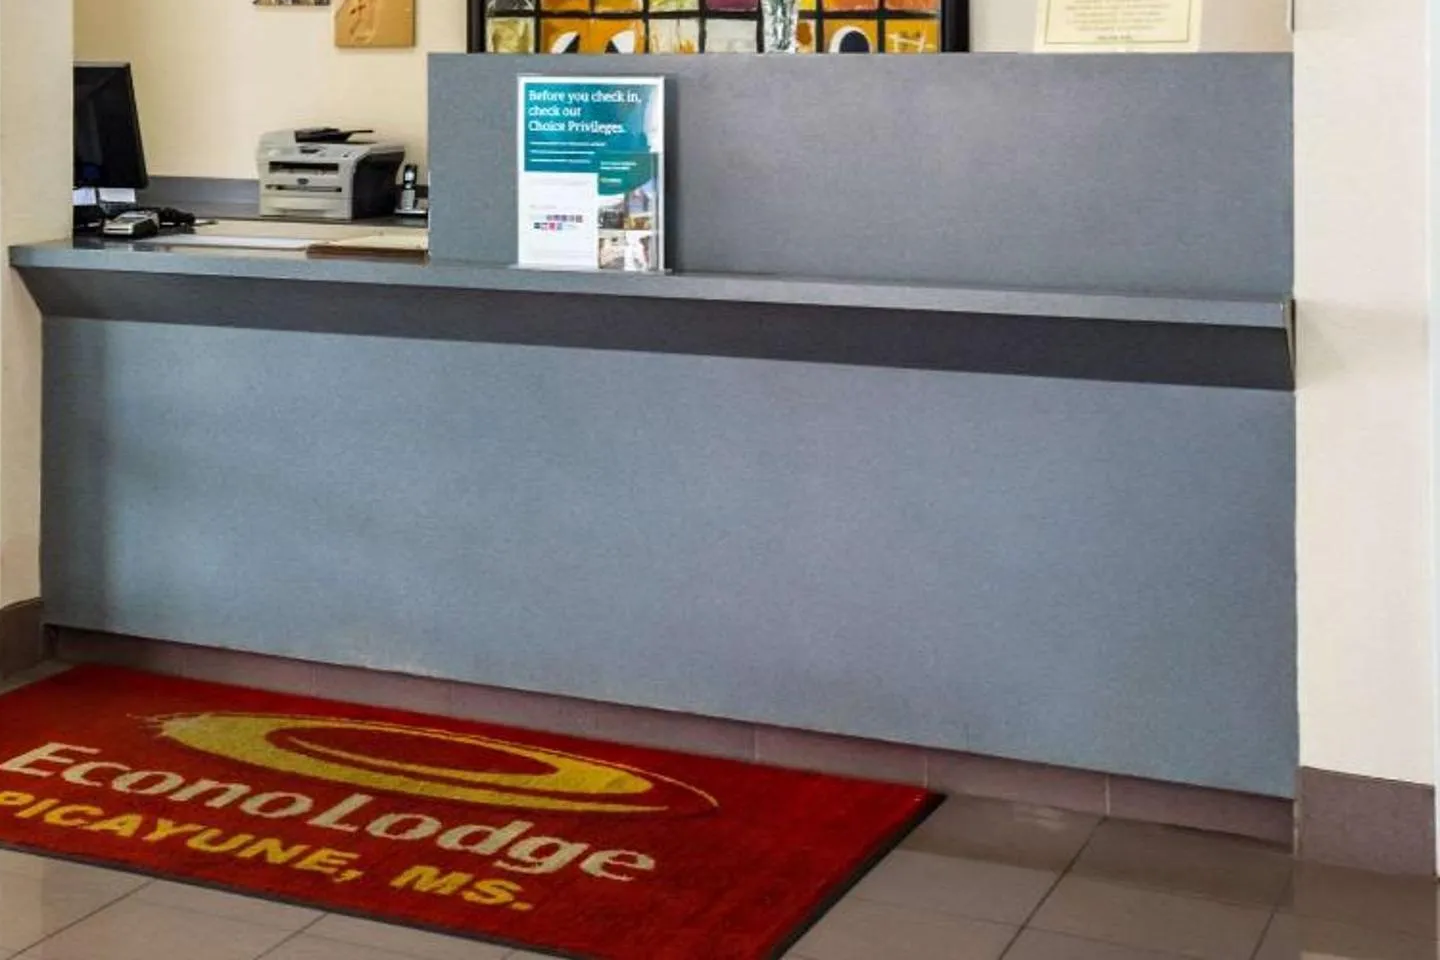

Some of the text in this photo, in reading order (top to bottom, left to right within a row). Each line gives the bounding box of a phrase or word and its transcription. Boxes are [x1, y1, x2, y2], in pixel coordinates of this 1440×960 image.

[528, 89, 565, 101] Before
[568, 92, 589, 104] you
[591, 90, 624, 103] check
[528, 105, 560, 116] check
[528, 121, 565, 132] Choice
[389, 865, 535, 911] MS.
